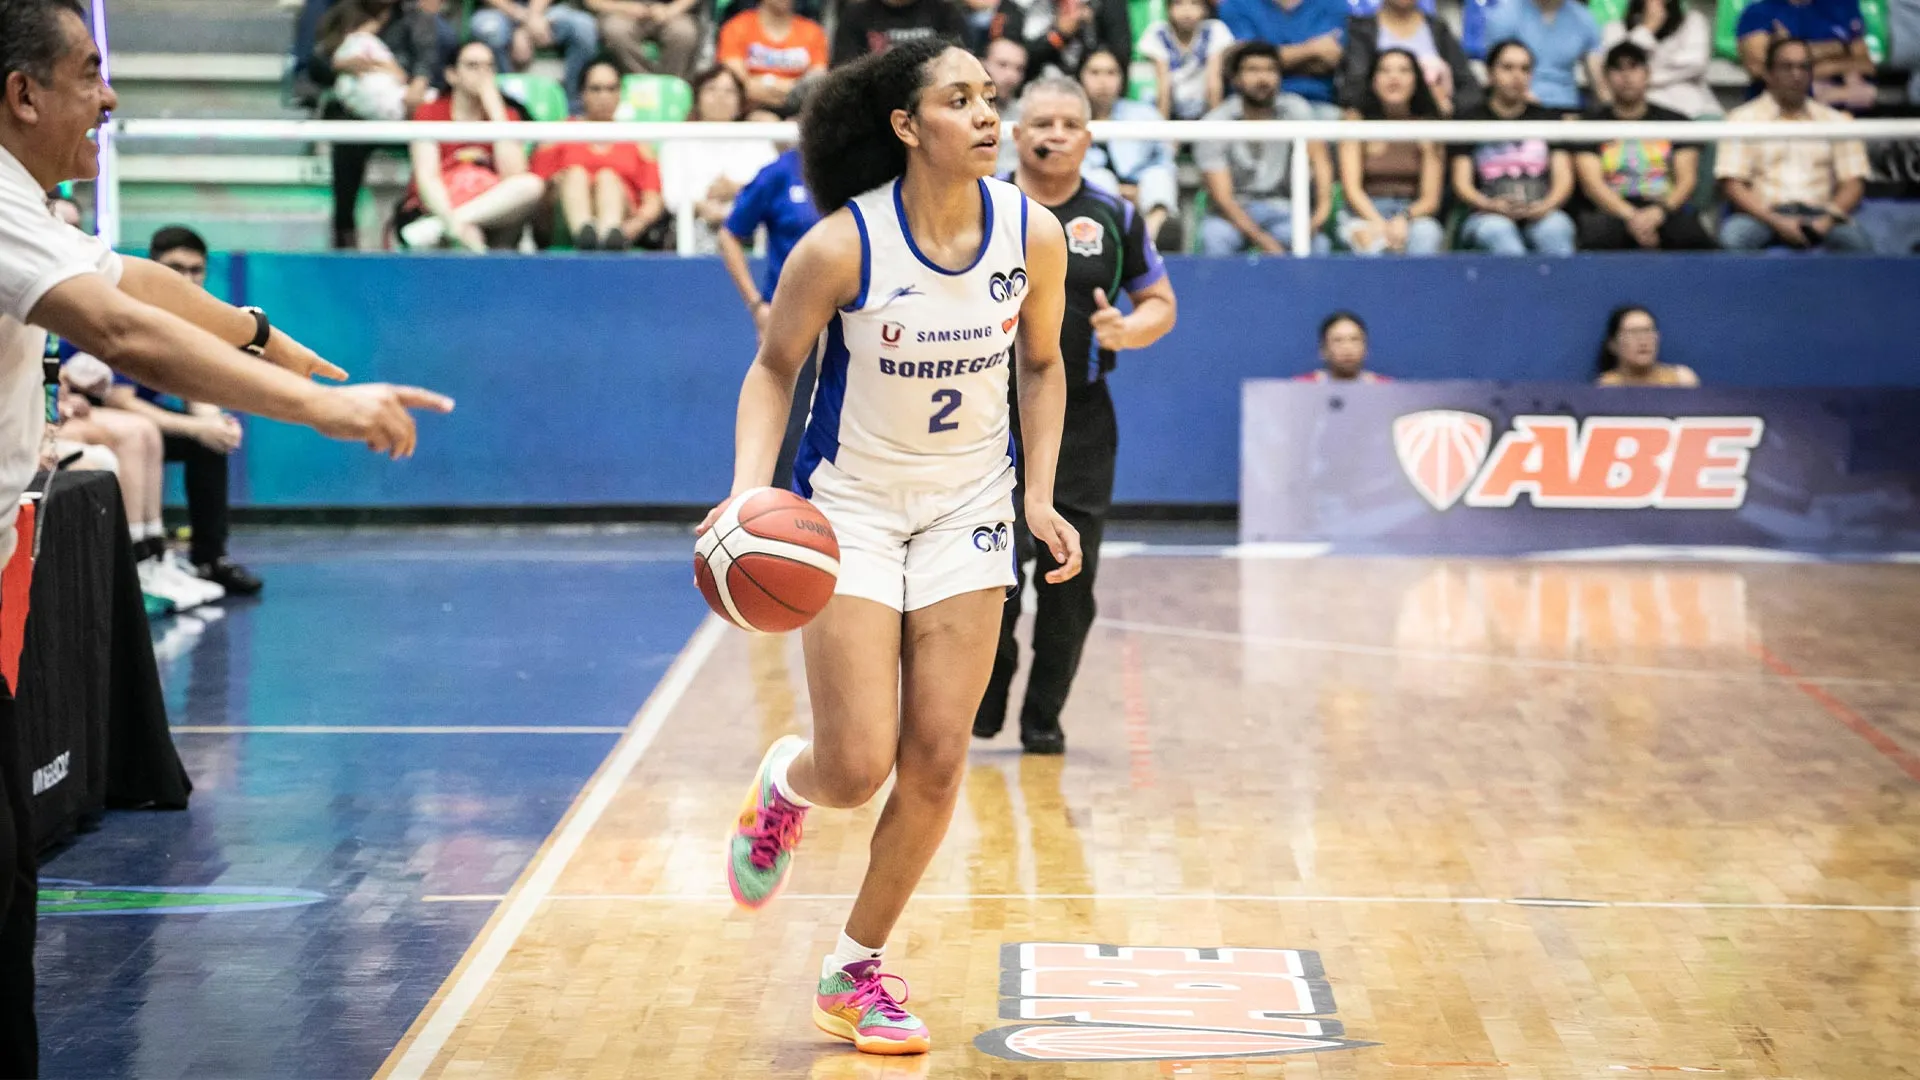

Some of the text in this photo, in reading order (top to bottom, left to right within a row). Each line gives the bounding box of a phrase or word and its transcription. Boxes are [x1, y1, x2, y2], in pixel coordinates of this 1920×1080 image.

[916, 326, 992, 343] SAMSUNG
[928, 388, 963, 434] 2
[1464, 415, 1764, 508] ABE
[999, 942, 1345, 1036] ABE
